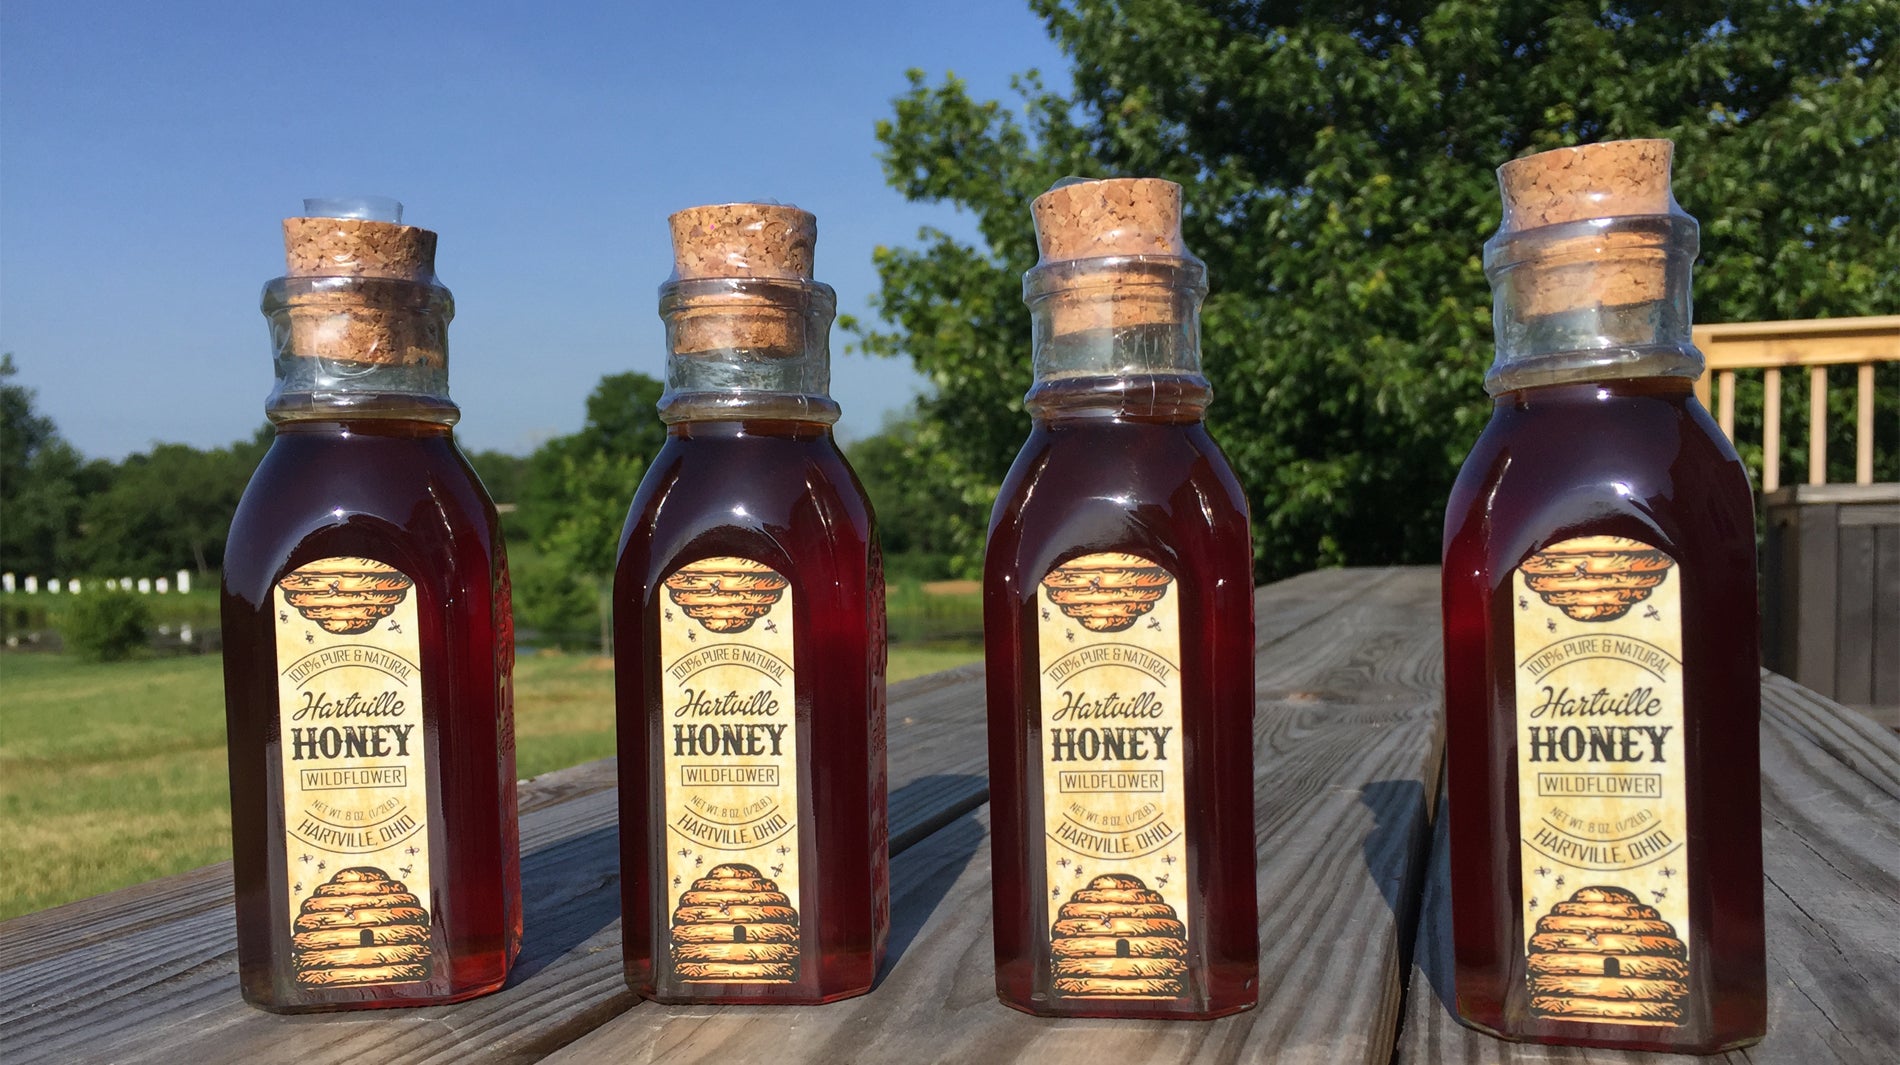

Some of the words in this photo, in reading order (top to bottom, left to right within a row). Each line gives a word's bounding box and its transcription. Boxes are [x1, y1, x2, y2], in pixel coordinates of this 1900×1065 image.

[288, 658, 320, 683] 100%
[321, 650, 350, 667] PURE
[354, 650, 362, 662] &
[364, 651, 411, 681] NATURAL
[672, 656, 702, 680] 100%
[702, 648, 729, 664] PURE
[732, 648, 740, 660] &
[742, 650, 786, 681] NATURAL
[1050, 656, 1080, 682] 100%
[1080, 648, 1110, 664] PURE
[1113, 648, 1120, 660] &
[1124, 650, 1170, 681] NATURAL
[1528, 648, 1564, 676] 100%
[1563, 639, 1598, 656] PURE
[1602, 639, 1611, 652] &
[1615, 641, 1670, 675] NATURAL
[292, 691, 406, 721] Hartville
[674, 688, 779, 718] Hartville
[1052, 691, 1164, 721] Hartville
[1530, 686, 1662, 719] Hartville
[291, 724, 414, 760] HONEY
[673, 724, 788, 756] HONEY
[1050, 726, 1173, 762] HONEY
[1528, 726, 1672, 762] HONEY
[306, 770, 401, 786] WILDFLOWER
[686, 768, 774, 782] WILDFLOWER
[1064, 774, 1158, 788] WILDFLOWER
[1544, 776, 1656, 792] WILDFLOWER
[312, 800, 328, 813] NET
[346, 812, 351, 820] 8
[691, 795, 706, 809] NET
[722, 808, 728, 818] 8
[1070, 802, 1086, 817] NET
[1102, 816, 1108, 825] 8
[1550, 806, 1568, 822] NET
[1588, 823, 1594, 832] 8
[380, 814, 416, 842] OHIO
[753, 814, 788, 840] OHIO
[1136, 821, 1173, 850] OHIO
[1628, 830, 1672, 860] OHIO
